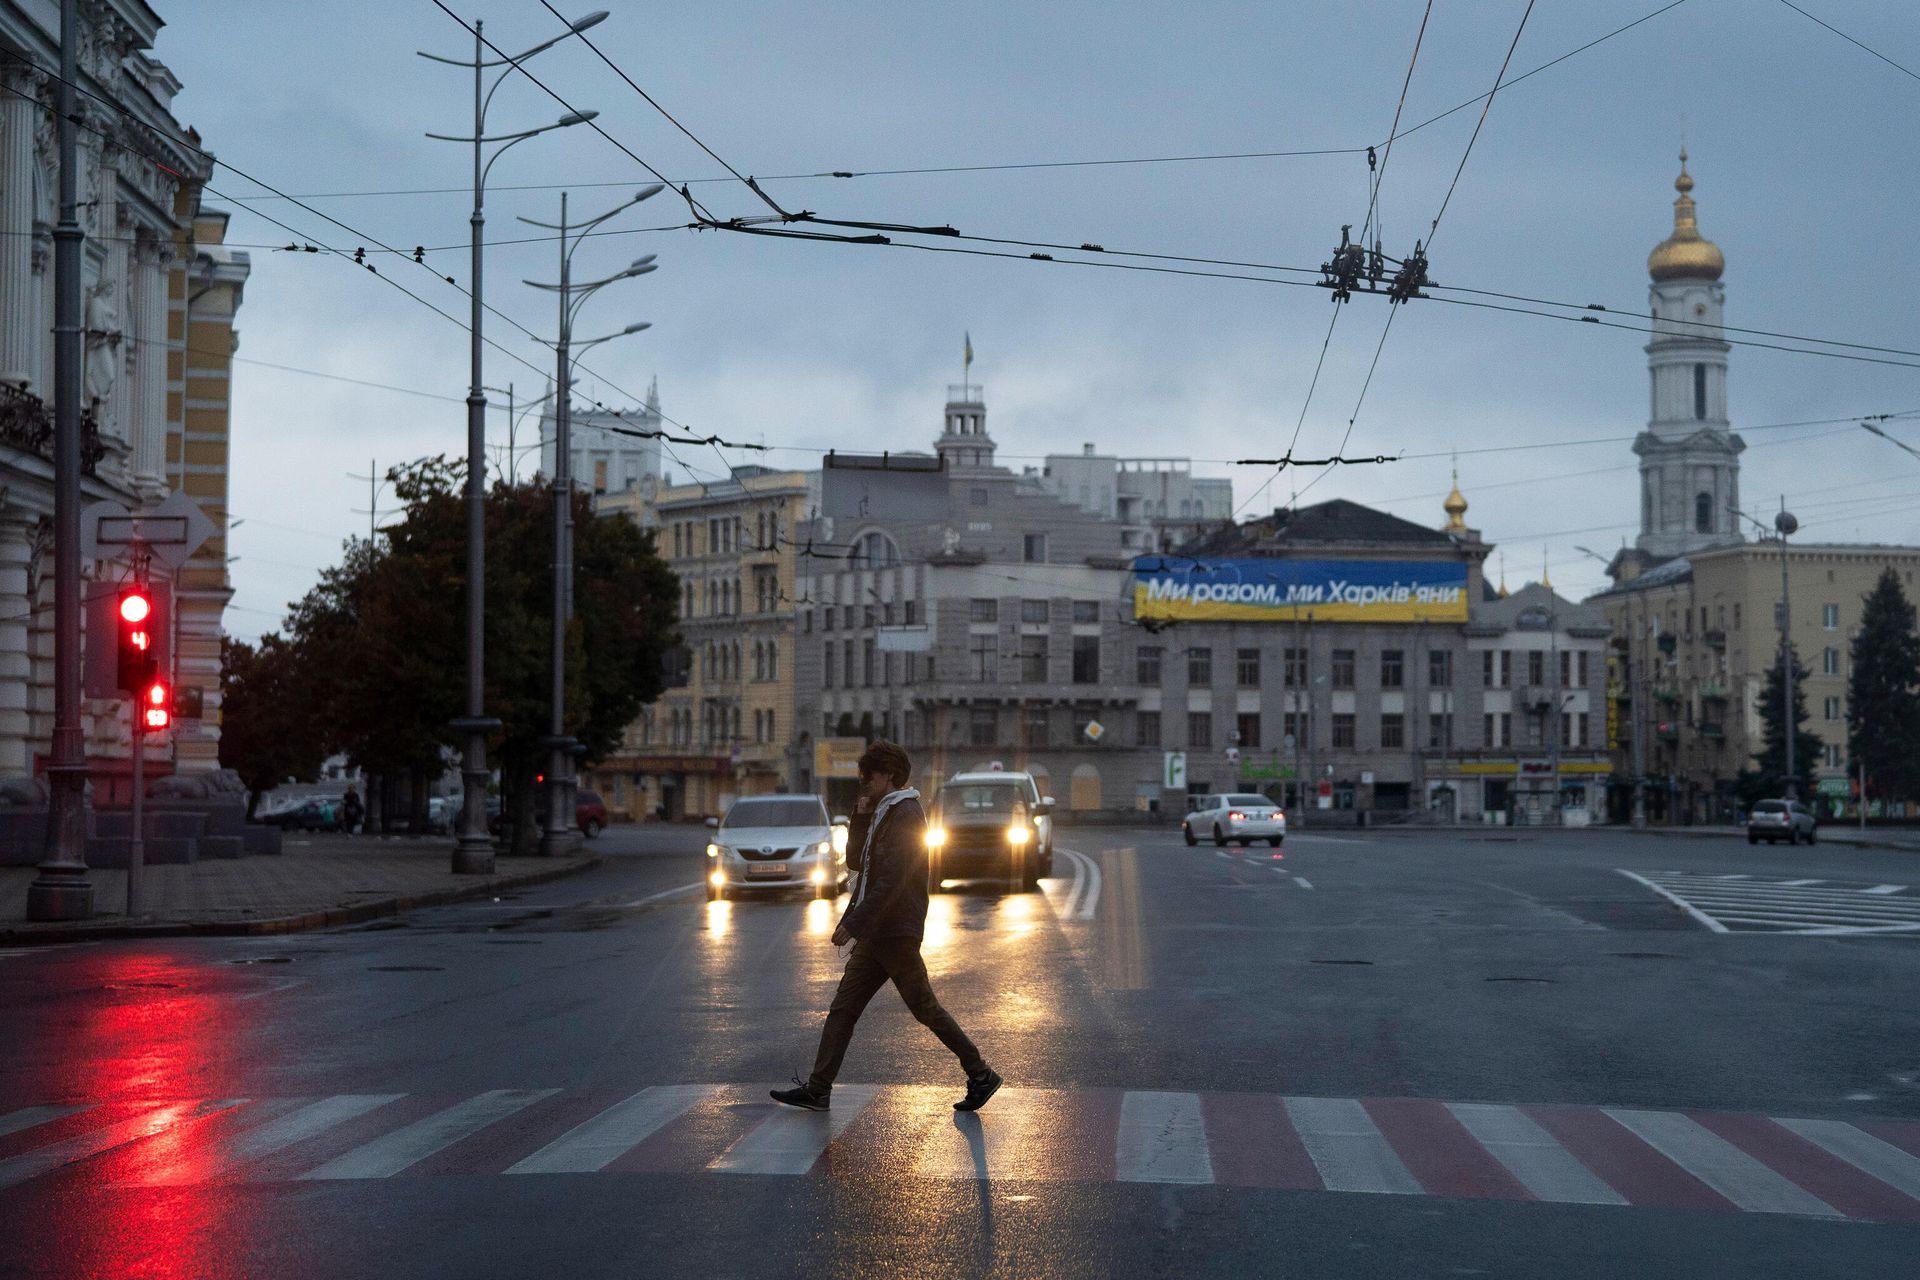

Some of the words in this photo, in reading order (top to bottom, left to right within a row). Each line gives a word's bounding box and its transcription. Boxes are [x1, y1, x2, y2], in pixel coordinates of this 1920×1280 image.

[1147, 577, 1189, 601] Ми
[1192, 582, 1280, 607] разом,
[1286, 584, 1323, 602] ми
[1326, 579, 1460, 608] Харків'яни
[131, 631, 146, 650] 4
